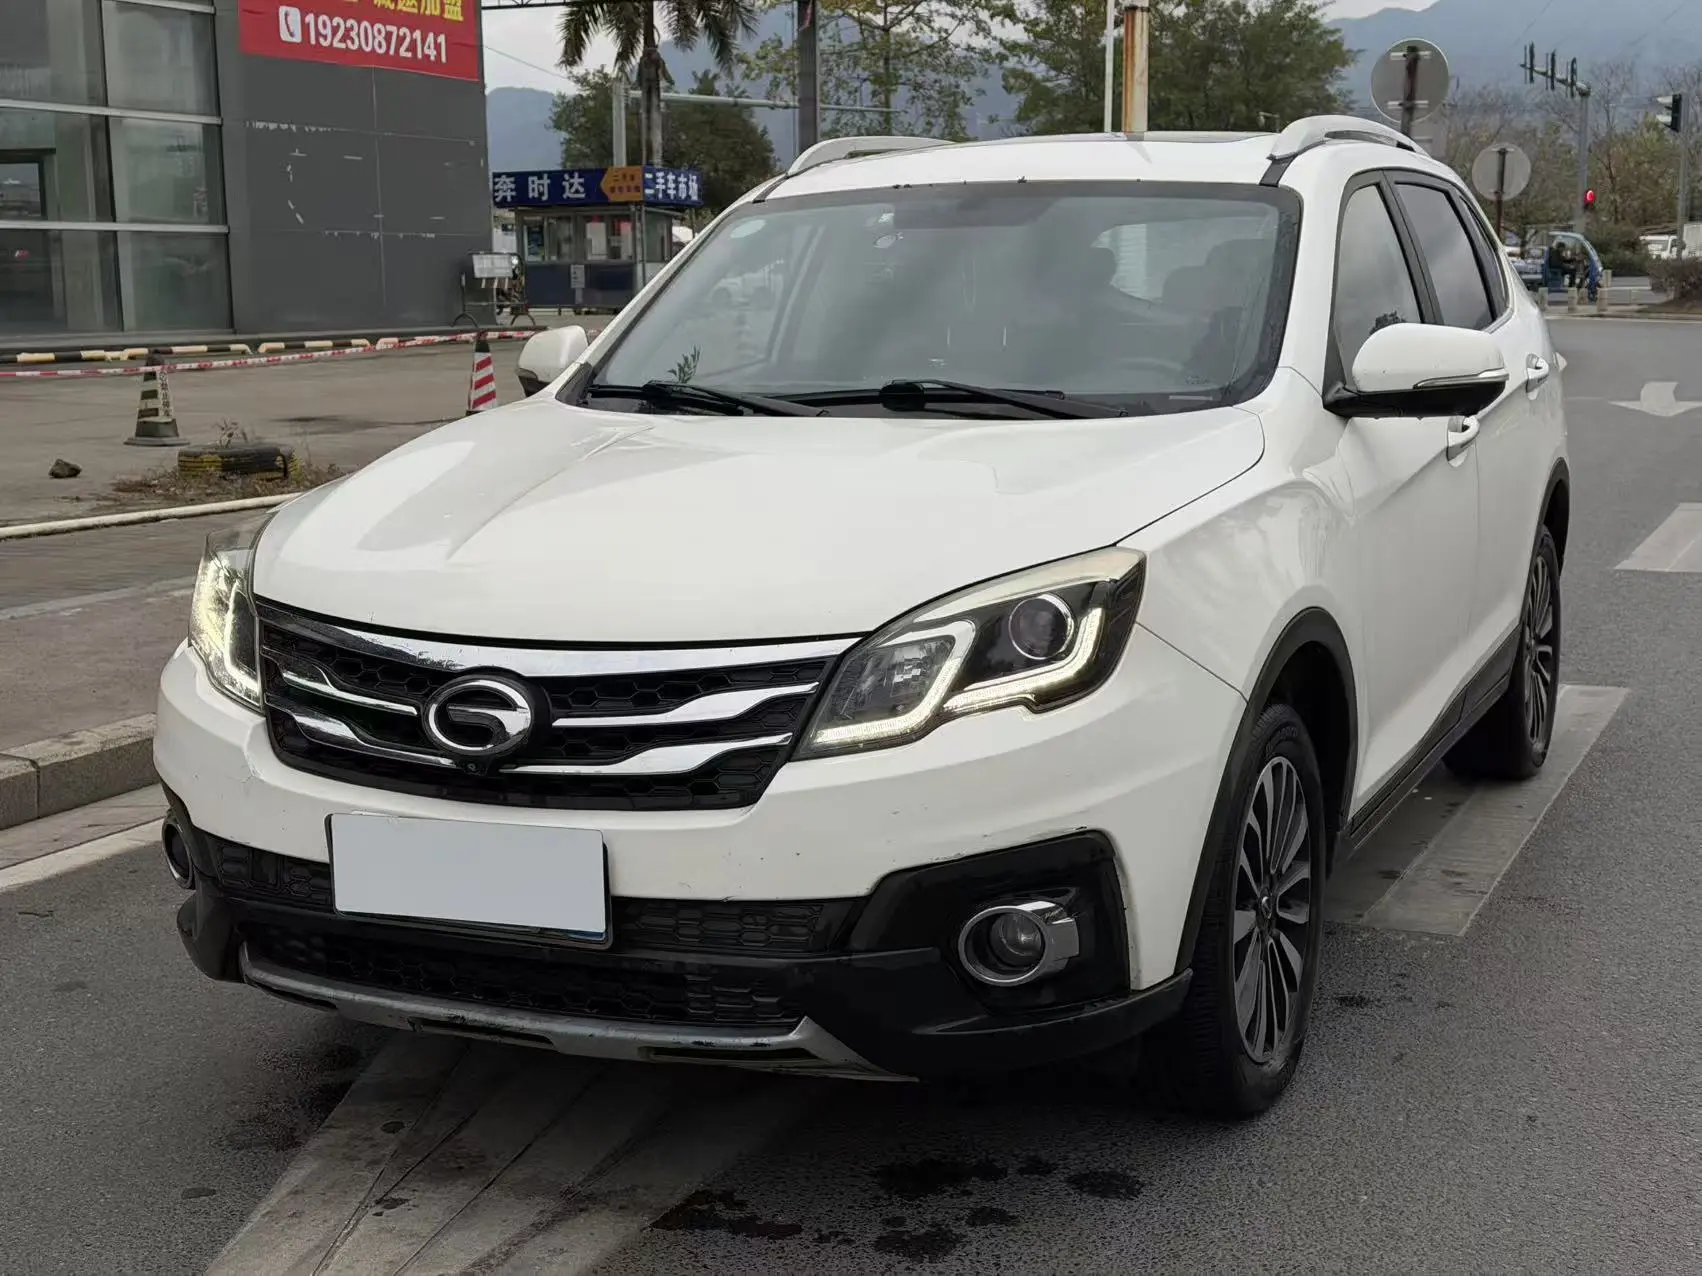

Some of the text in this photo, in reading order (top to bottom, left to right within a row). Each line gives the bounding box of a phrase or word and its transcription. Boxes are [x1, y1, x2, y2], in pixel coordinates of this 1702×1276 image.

[304, 13, 447, 63] 19230872141
[493, 173, 586, 202] 奔时达
[644, 171, 699, 201] 二手车市场
